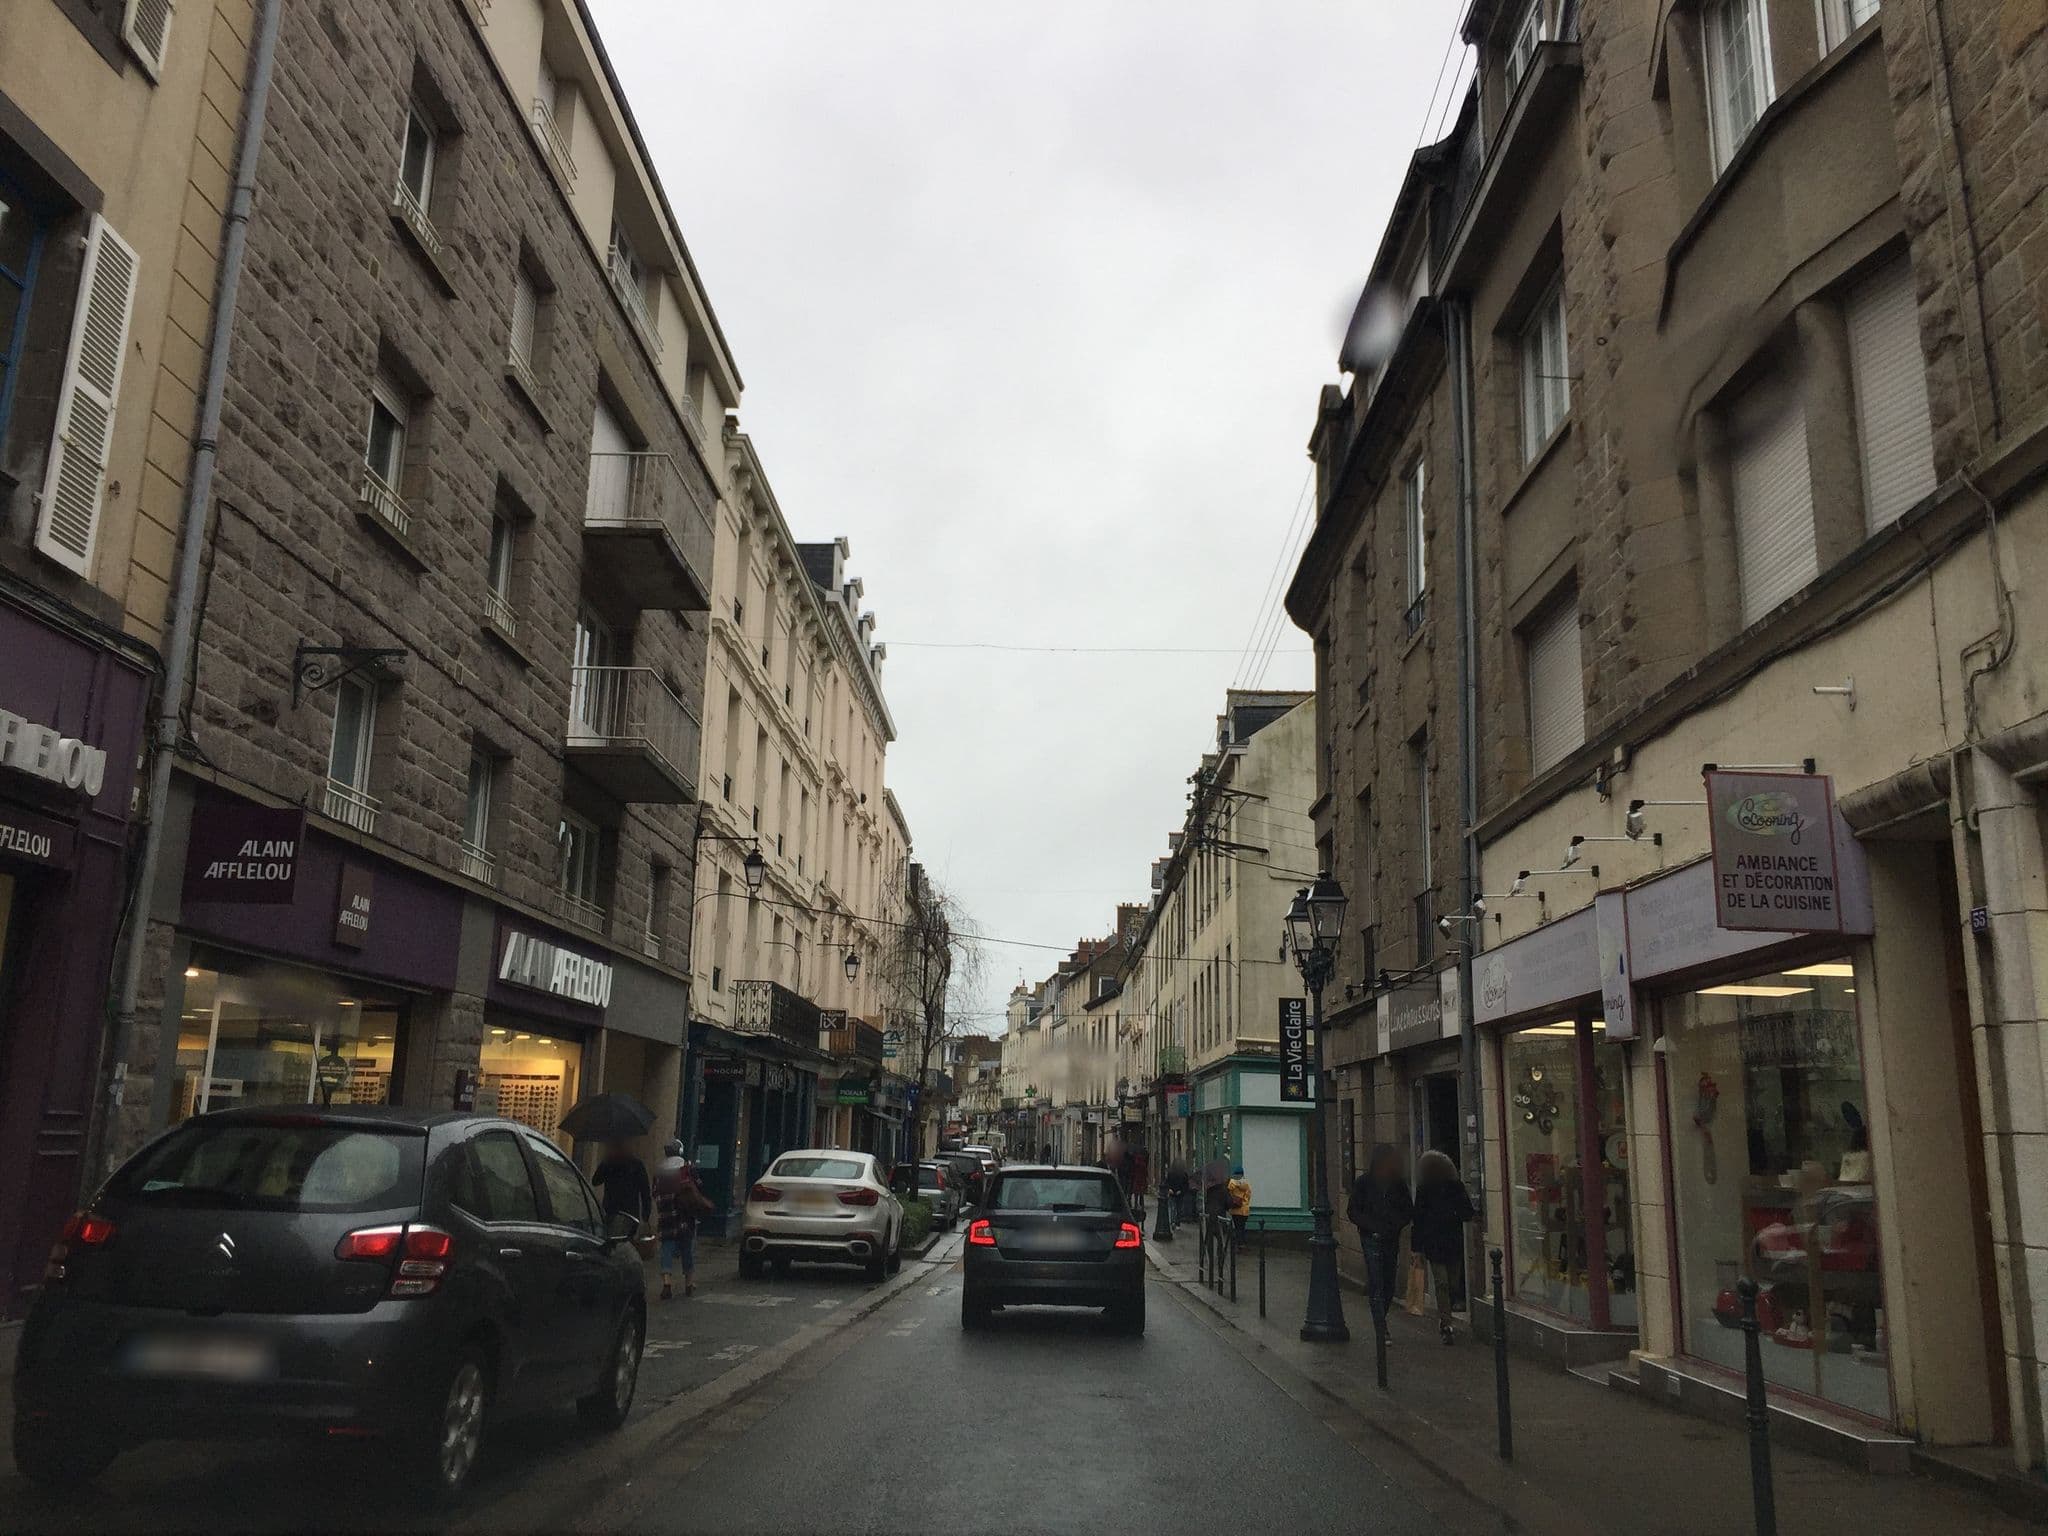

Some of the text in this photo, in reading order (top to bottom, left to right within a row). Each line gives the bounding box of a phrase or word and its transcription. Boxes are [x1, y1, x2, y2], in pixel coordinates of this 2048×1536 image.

[1737, 798, 1805, 846] Cocooning
[237, 839, 294, 857] ALAIN
[204, 861, 292, 880] AFFLELOU
[1736, 855, 1818, 872] AMBIANCE
[1722, 872, 1833, 891] ET DÉCORATION
[351, 894, 370, 912] ALAIN
[1727, 893, 1832, 911] DE LA CUISINE
[339, 910, 369, 931] AFFLELOU
[1972, 911, 1986, 928] 55
[549, 947, 613, 1008] AFFLELOU
[1284, 1000, 1303, 1080] La Vie Claire
